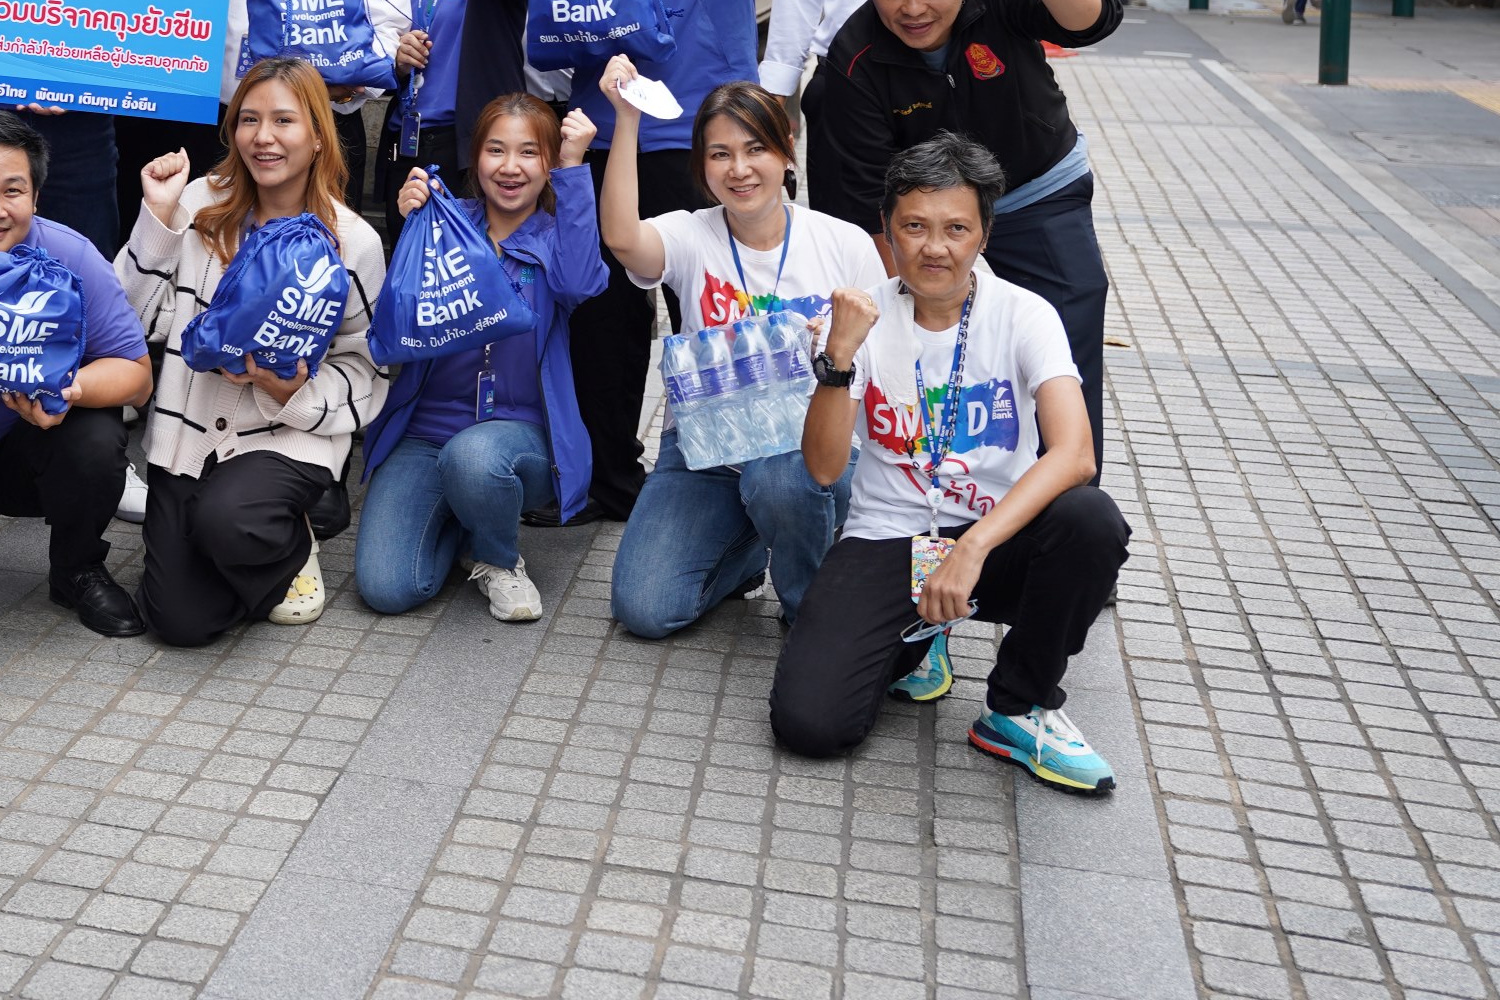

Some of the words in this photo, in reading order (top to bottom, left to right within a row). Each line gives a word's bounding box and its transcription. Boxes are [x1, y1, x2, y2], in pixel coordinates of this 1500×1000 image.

[281, 8, 346, 23] Dvelopment
[282, 19, 348, 46] Bank
[540, 35, 562, 43] ธพว.
[35, 86, 74, 104] พัฒนา
[78, 93, 118, 110] เติมทุน
[122, 91, 157, 112] ยั่งยืน
[276, 286, 342, 327] SME
[417, 289, 484, 327] Bank
[267, 310, 328, 337] Development
[253, 320, 319, 357] Bank
[401, 336, 426, 348] ธพว.
[946, 387, 954, 400] SME
[992, 399, 1012, 410] SME
[967, 401, 989, 436] D
[992, 411, 1014, 420] Bank
